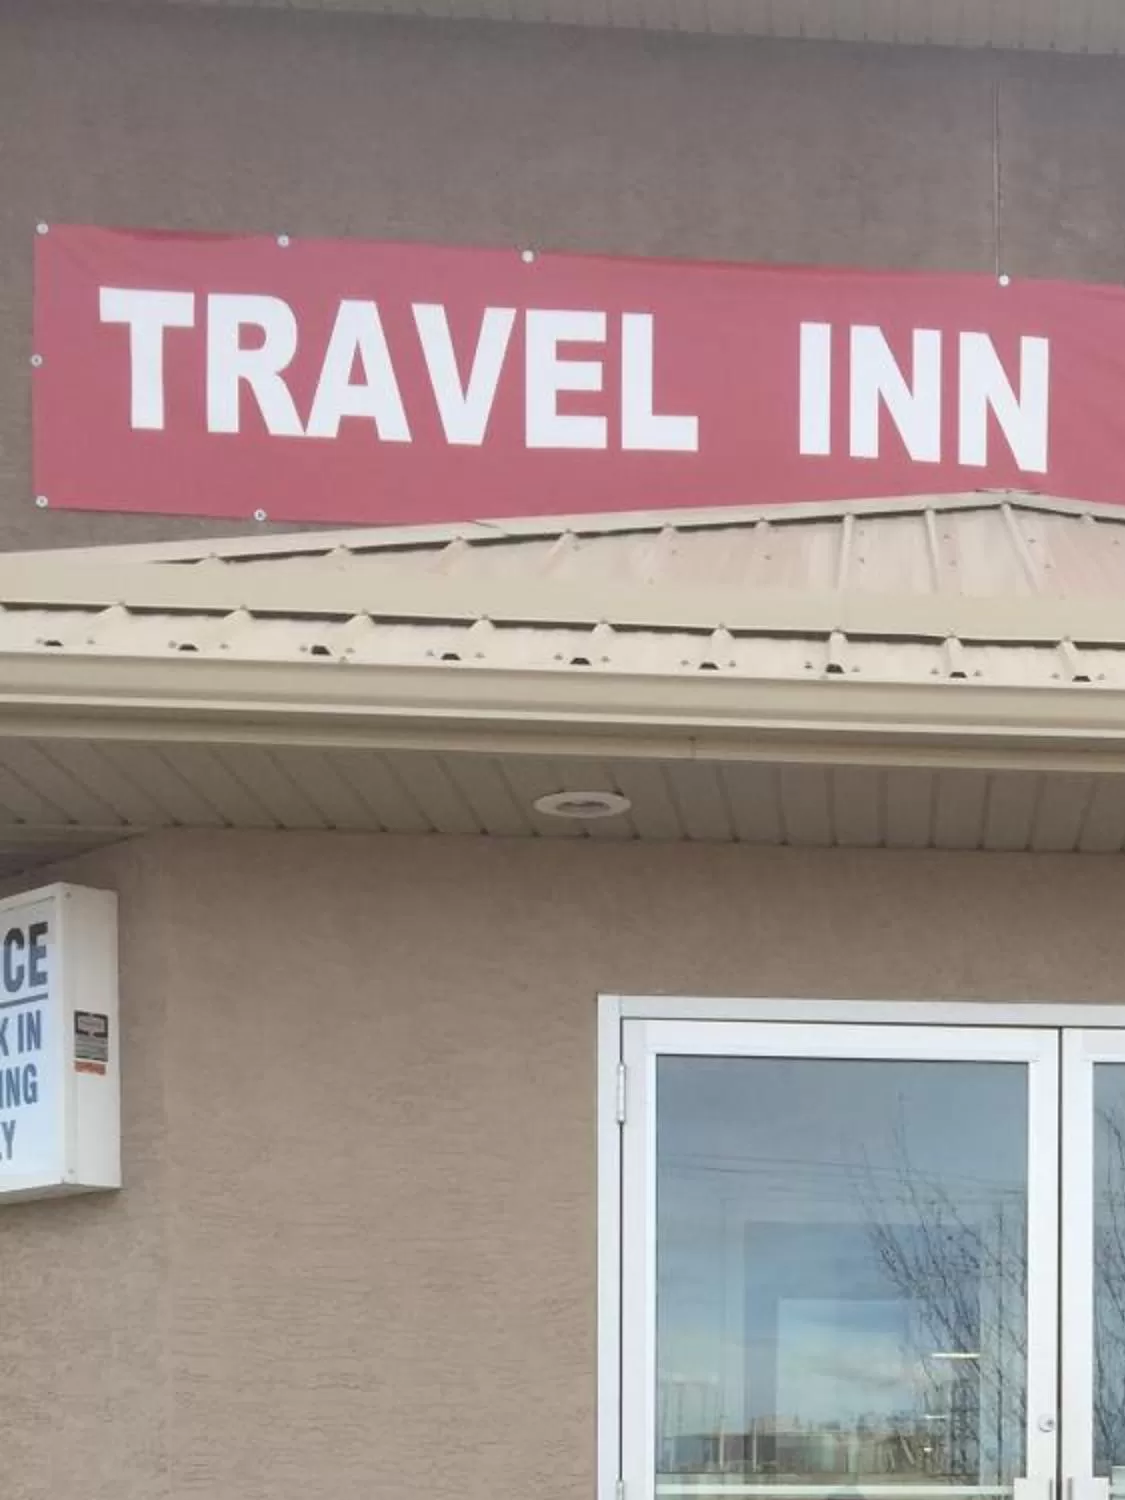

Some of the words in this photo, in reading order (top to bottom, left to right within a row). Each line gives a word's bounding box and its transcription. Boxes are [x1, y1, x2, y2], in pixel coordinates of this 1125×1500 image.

[99, 287, 699, 451] TRAVEL
[799, 323, 1050, 473] INN
[3, 921, 48, 992] CE
[17, 1009, 42, 1054] IN
[0, 1119, 16, 1160] Y
